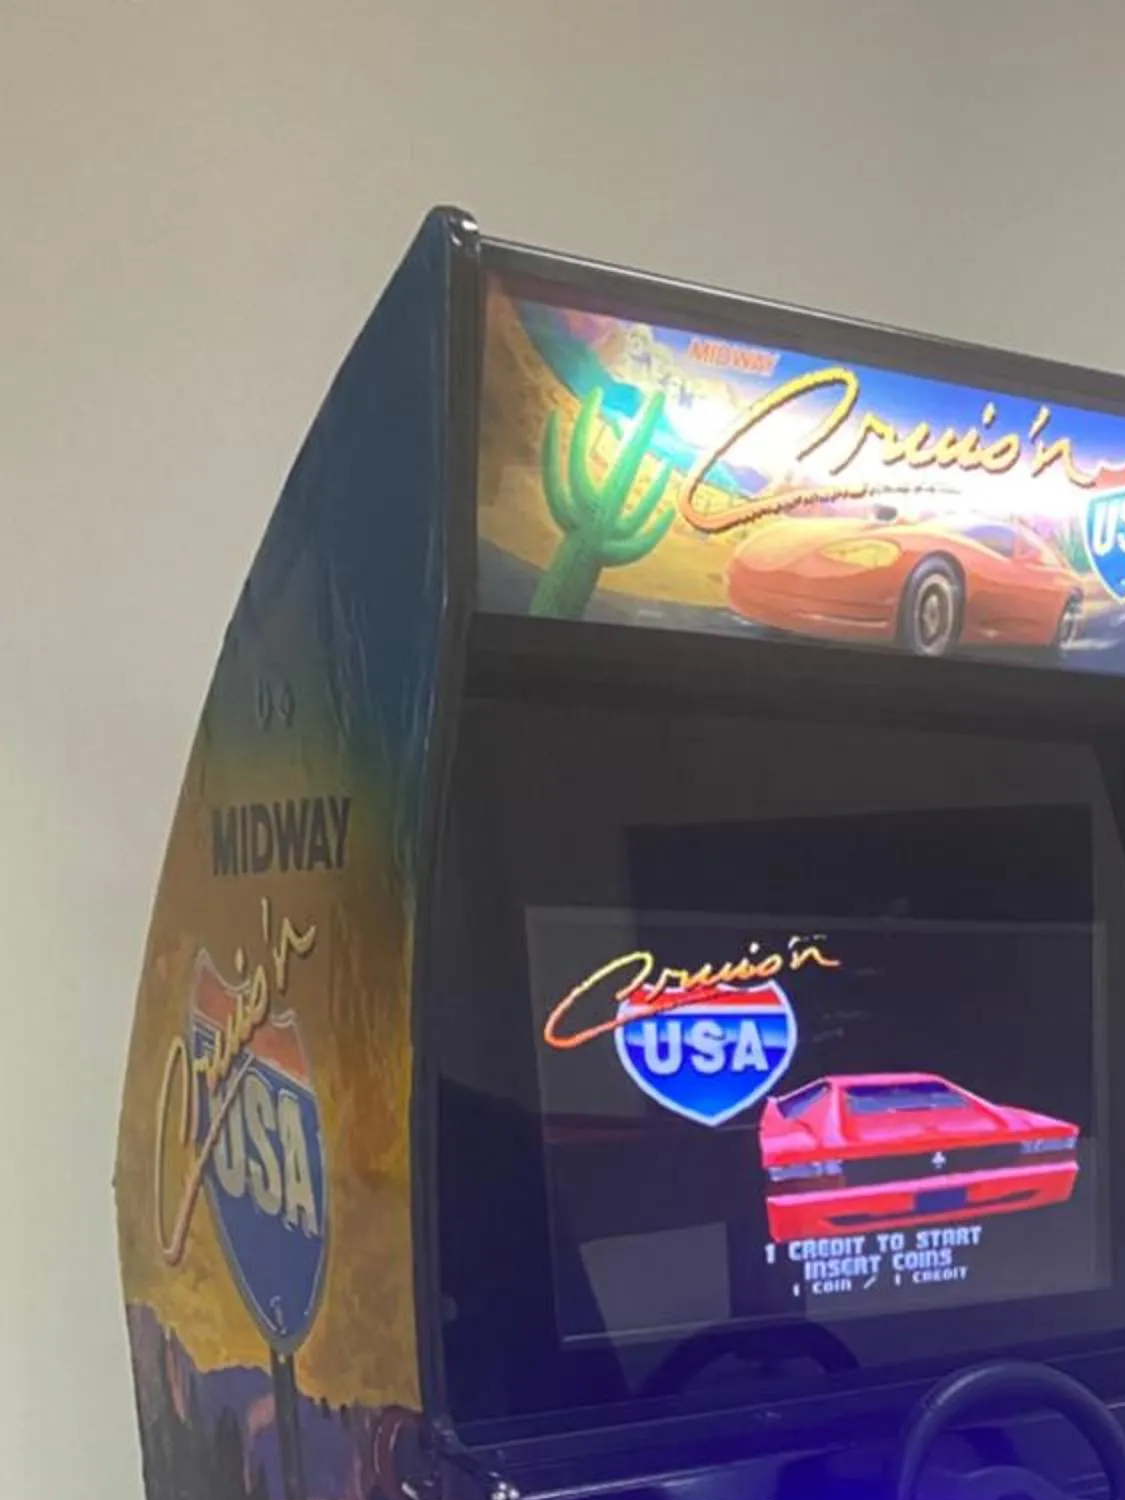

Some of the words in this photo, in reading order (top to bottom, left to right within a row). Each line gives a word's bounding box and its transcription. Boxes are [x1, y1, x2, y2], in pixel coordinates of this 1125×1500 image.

[687, 338, 780, 378] MIDWAY
[681, 366, 1098, 535] Cruis'n
[210, 797, 352, 877] MIDWAY
[639, 1018, 770, 1077] USA
[208, 1074, 319, 1239] USA
[764, 1243, 776, 1264] 1
[788, 1235, 865, 1261] CREDIT
[877, 1232, 905, 1253] TO
[915, 1225, 983, 1249] START
[804, 1255, 882, 1281] INSERT
[892, 1249, 953, 1271] COINS
[812, 1278, 853, 1294] COIN
[911, 1266, 969, 1284] CREDIT
